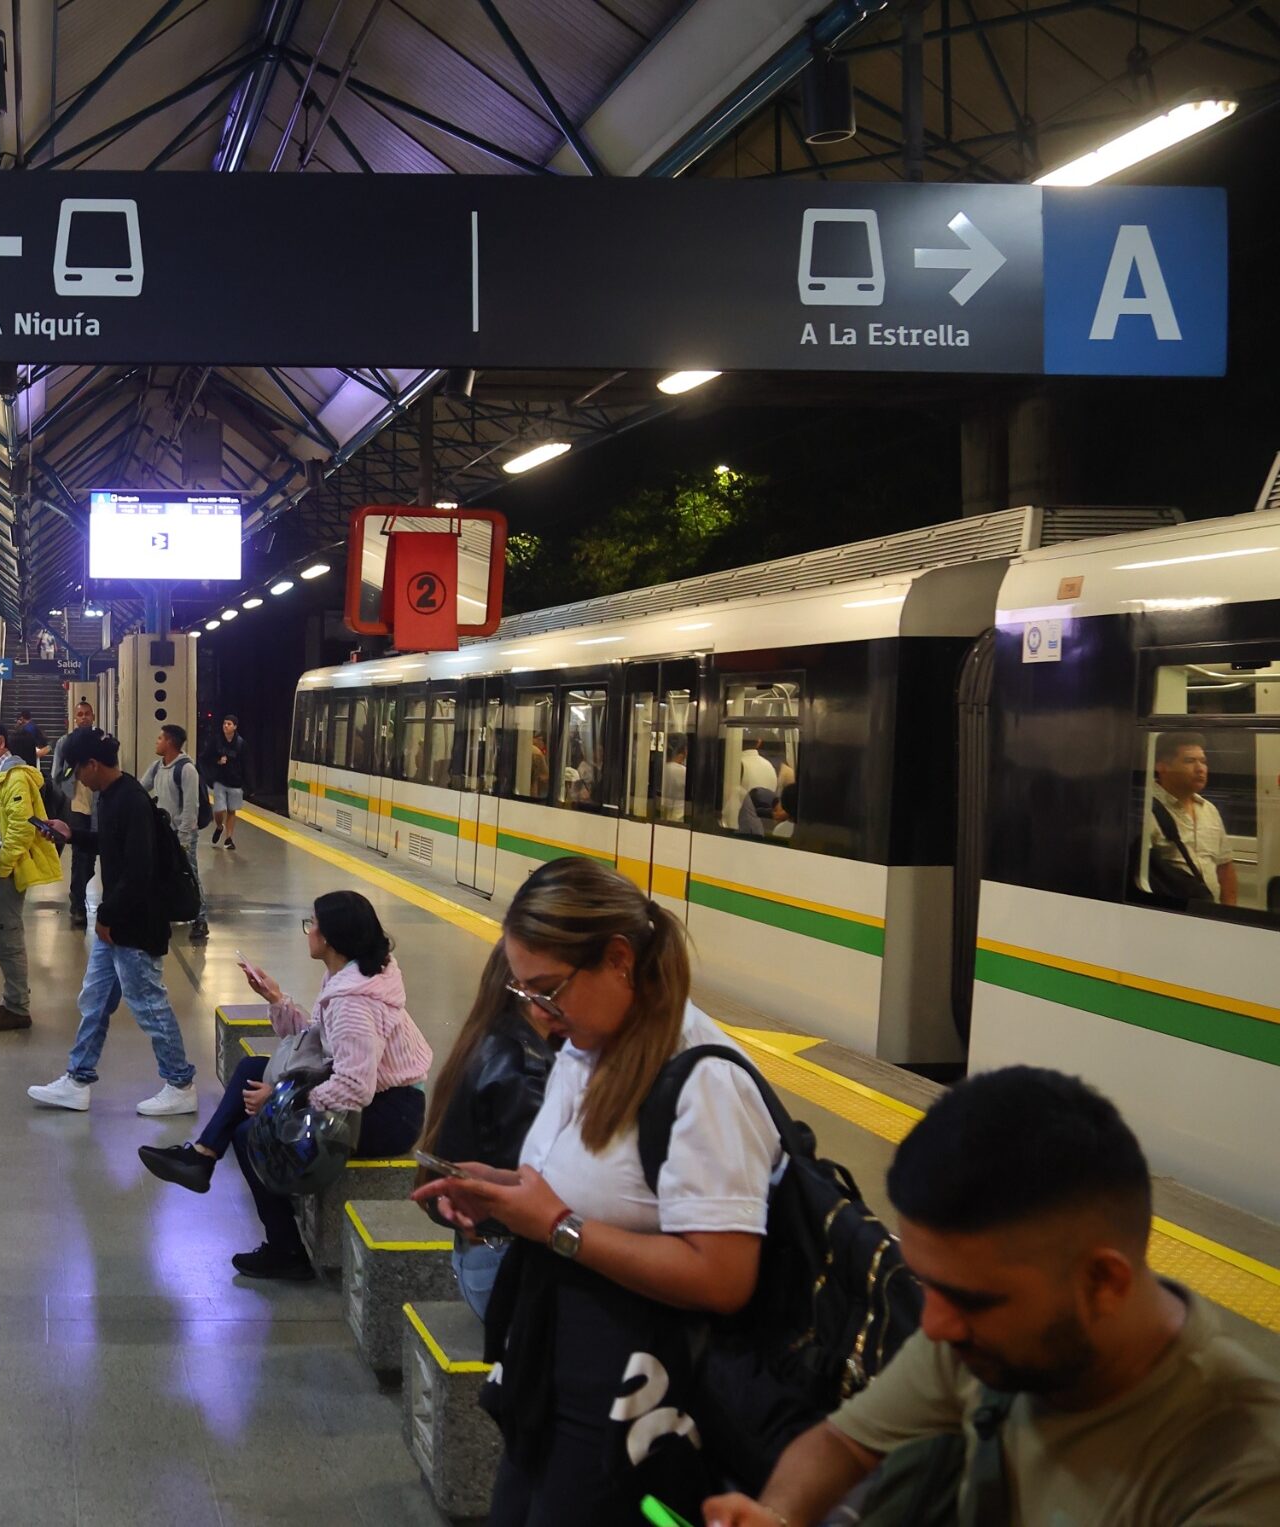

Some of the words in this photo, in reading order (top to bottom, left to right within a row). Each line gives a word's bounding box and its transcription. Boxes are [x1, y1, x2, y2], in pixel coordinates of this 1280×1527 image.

[1088, 225, 1183, 341] A
[14, 312, 101, 341] Niquía
[800, 322, 818, 345] A
[829, 323, 857, 345] La
[868, 323, 970, 347] Estrella
[416, 576, 436, 608] 2
